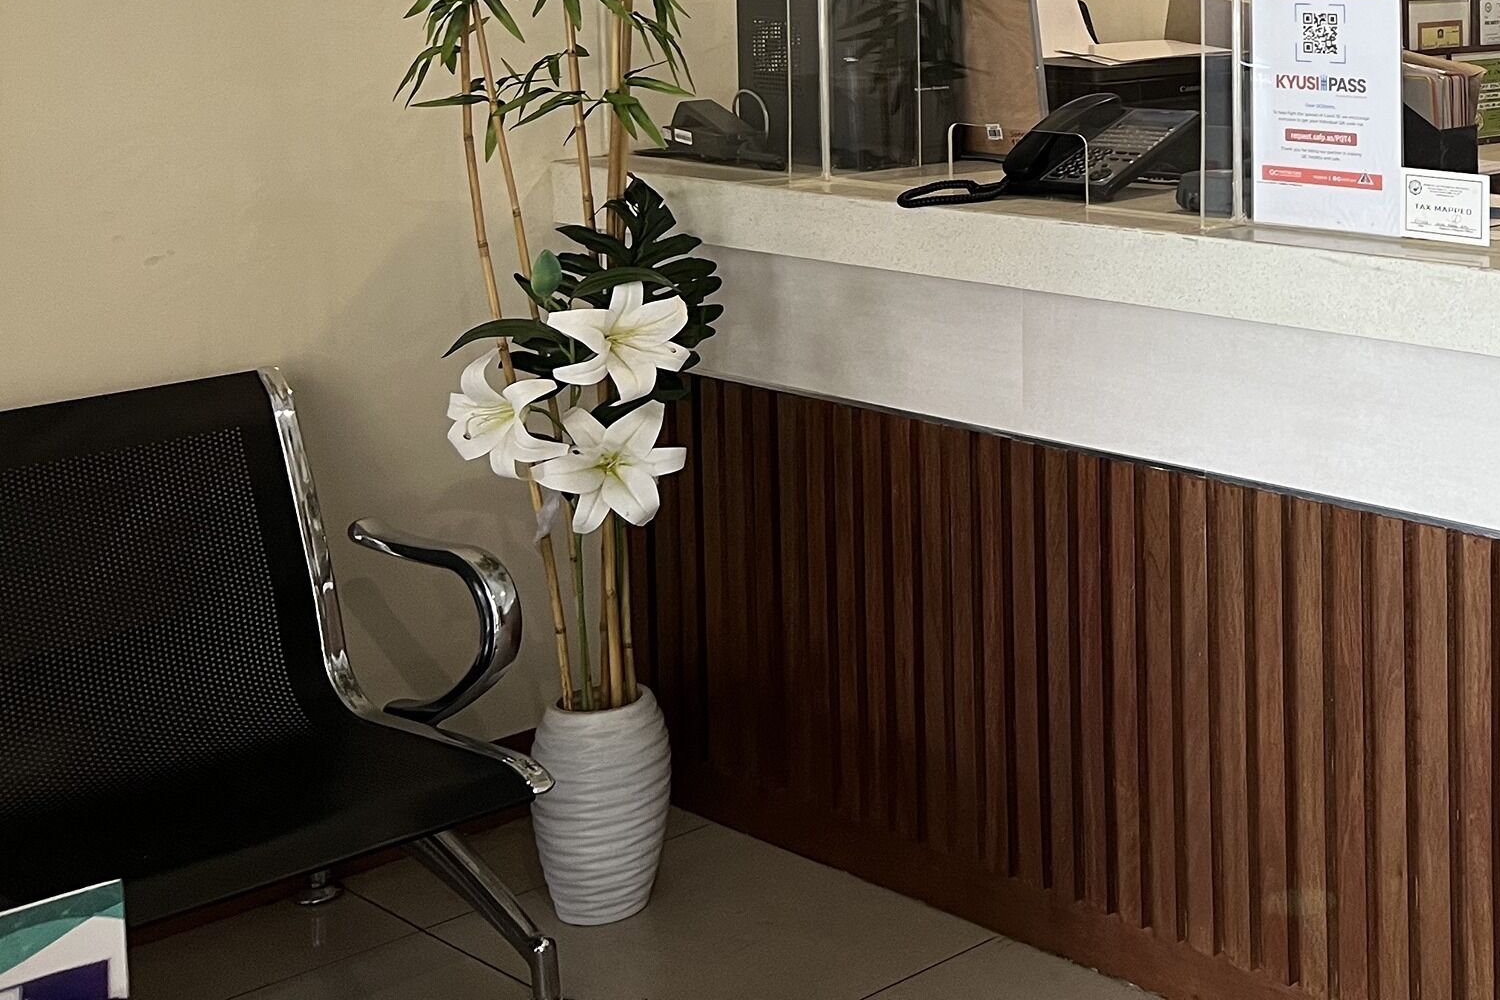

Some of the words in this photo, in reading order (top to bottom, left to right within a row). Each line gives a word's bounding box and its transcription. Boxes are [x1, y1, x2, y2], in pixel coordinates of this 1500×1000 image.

[1276, 74, 1319, 91] KYUSI
[1328, 77, 1367, 93] PASS
[1415, 203, 1432, 211] TAX
